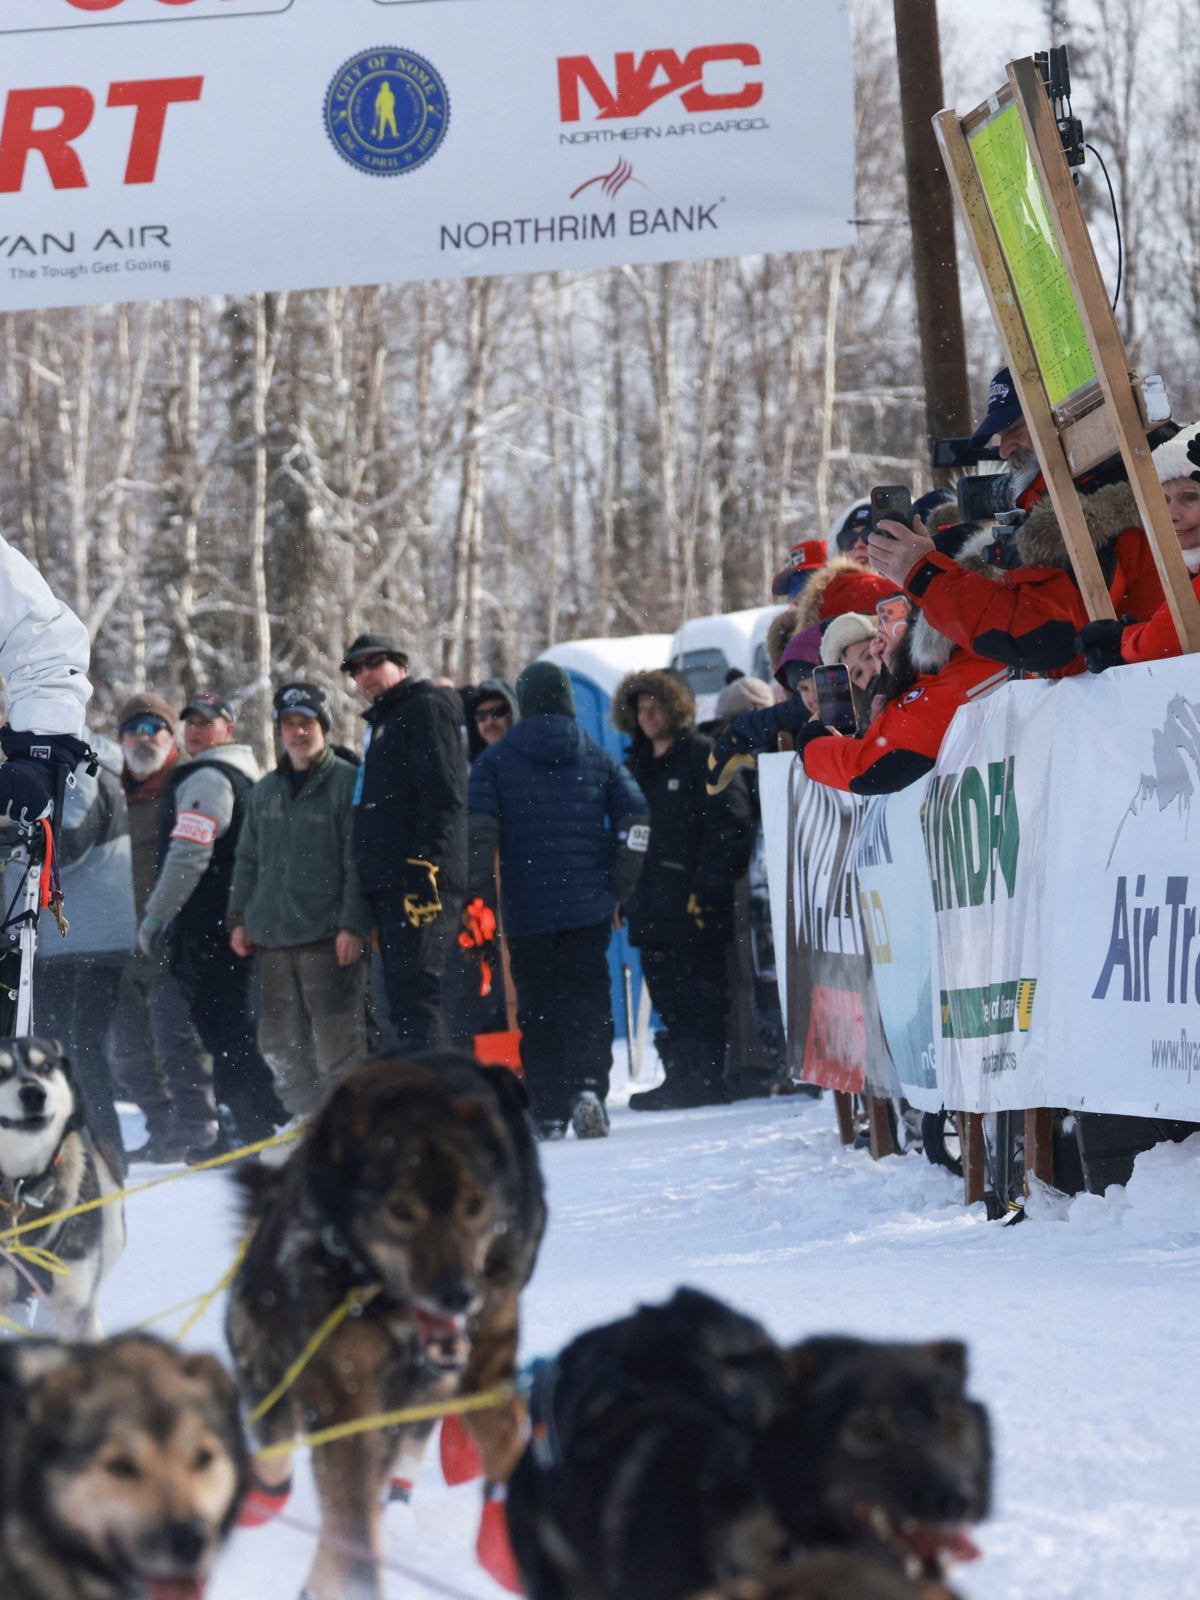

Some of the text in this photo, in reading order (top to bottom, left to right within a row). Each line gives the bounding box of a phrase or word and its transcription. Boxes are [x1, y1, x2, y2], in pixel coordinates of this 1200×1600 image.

[557, 42, 763, 122] NAC
[559, 126, 661, 145] NORTHERN
[665, 123, 696, 137] AIR
[94, 225, 172, 251] AIR
[440, 203, 718, 251] NORTHRIM BANK
[9, 257, 172, 280] The Tough Get Going
[1091, 874, 1200, 1004] Air Tr
[1152, 1028, 1200, 1084] www.flya
